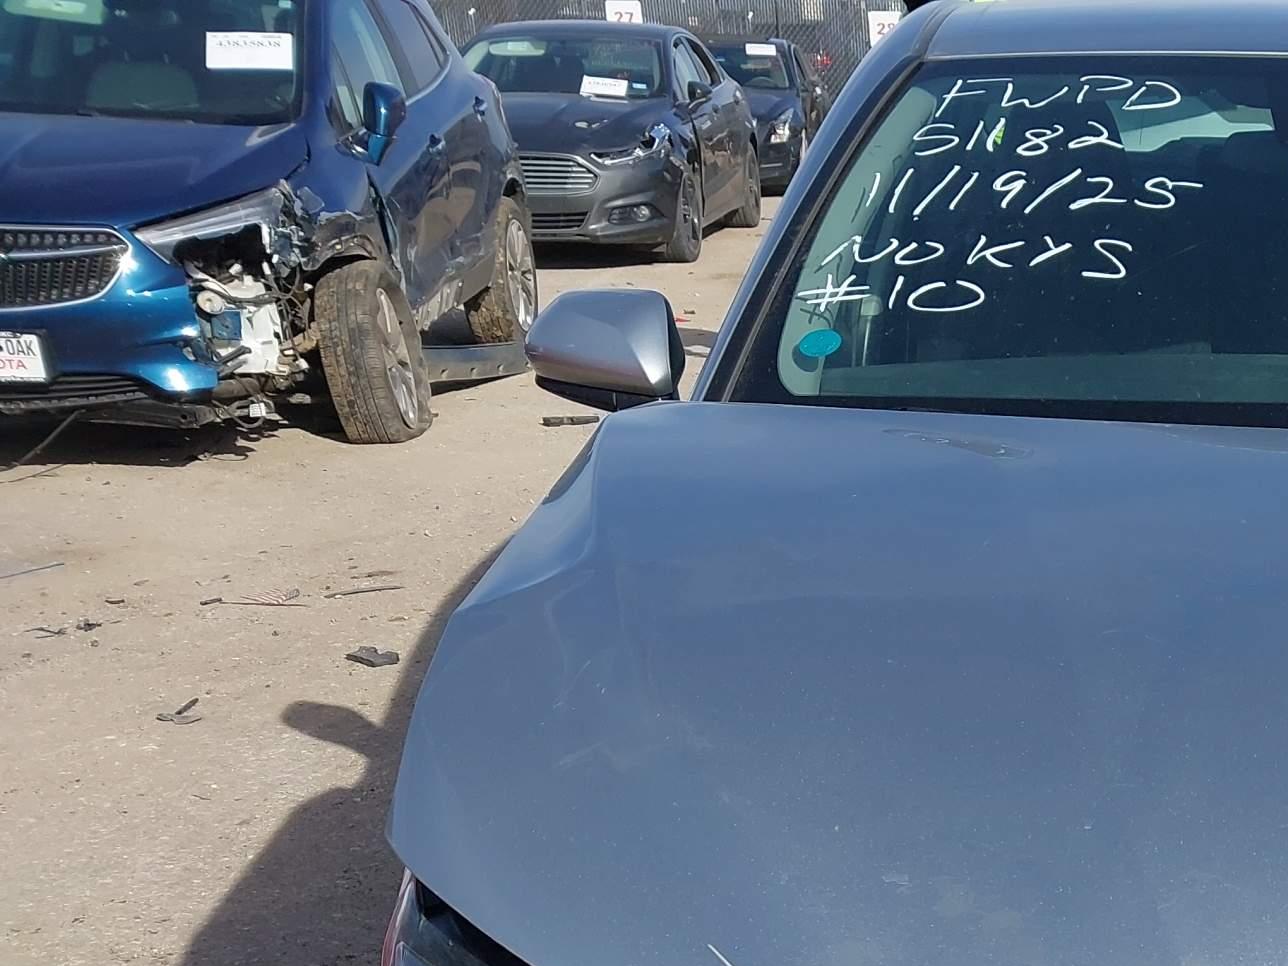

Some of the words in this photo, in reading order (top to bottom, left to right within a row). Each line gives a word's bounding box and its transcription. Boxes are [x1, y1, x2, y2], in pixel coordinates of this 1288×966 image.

[613, 11, 634, 23] 27
[934, 74, 1182, 118] FWPD
[866, 165, 1203, 217] 11/19/25
[820, 234, 945, 266] NO
[797, 273, 986, 312] #10
